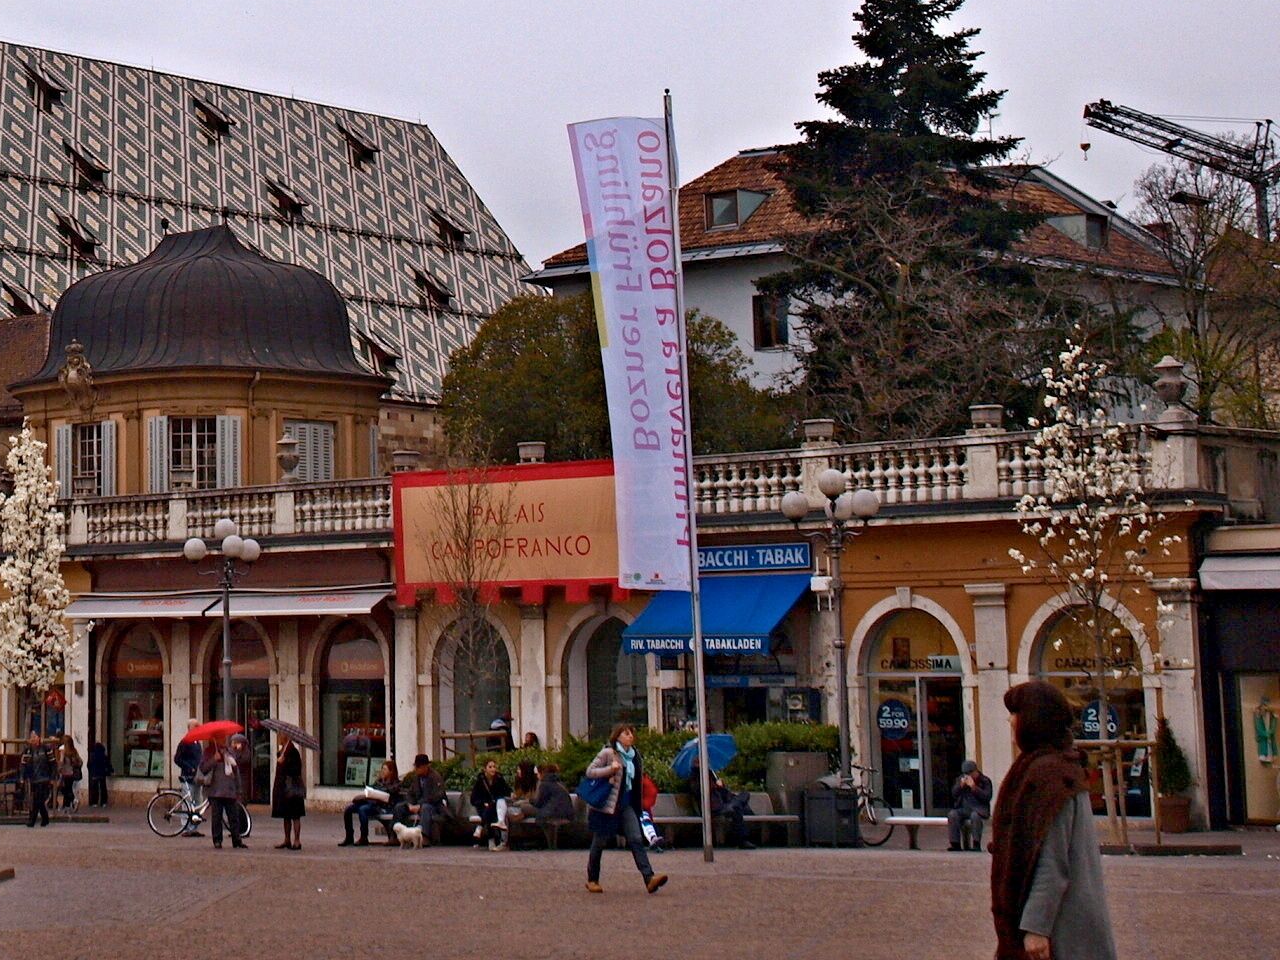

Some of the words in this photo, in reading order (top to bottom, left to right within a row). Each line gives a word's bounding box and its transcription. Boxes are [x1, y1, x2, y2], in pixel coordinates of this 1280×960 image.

[472, 502, 545, 526] PALAIS
[431, 534, 592, 560] CAMPOFRANCO
[756, 547, 805, 565] TABAK
[630, 640, 646, 650] RIV.
[647, 639, 684, 650] TABACCHI
[705, 639, 762, 650] TABAKLADEN
[881, 705, 891, 718] 2
[1087, 708, 1098, 721] 2
